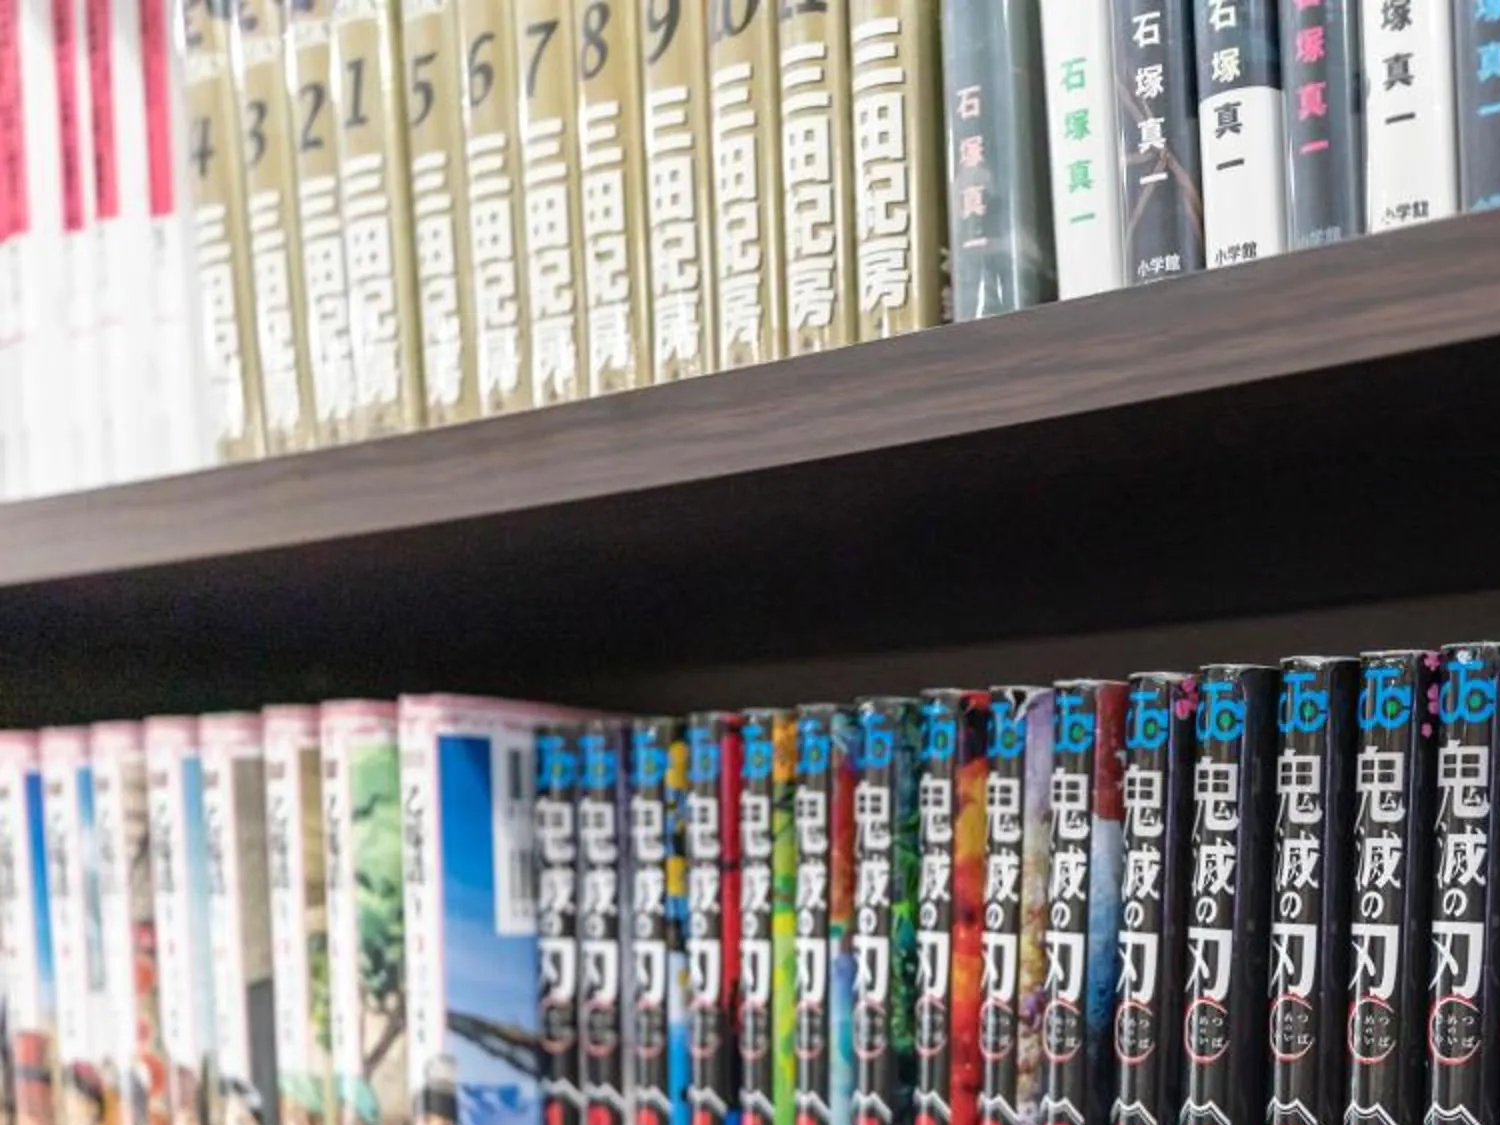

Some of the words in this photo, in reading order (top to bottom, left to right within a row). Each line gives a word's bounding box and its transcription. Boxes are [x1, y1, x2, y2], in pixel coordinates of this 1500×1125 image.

[300, 82, 325, 151] 2
[345, 57, 368, 128] 1
[411, 51, 438, 126] 5
[467, 33, 494, 106] 6
[525, 19, 559, 97] 7
[580, 0, 610, 80] 8
[1132, 11, 1168, 185] 石塚真一
[1209, 0, 1245, 171] 石塚真一
[1295, 0, 1329, 155] 塚真一
[247, 100, 268, 170] 3
[957, 85, 988, 248] 石塚真一
[1060, 57, 1095, 224] 石塚真一
[1382, 200, 1430, 225] 小学館
[1137, 254, 1181, 276] 小学館
[1215, 242, 1258, 265] 小学館
[687, 792, 720, 1001] 鬼滅の刃
[740, 790, 772, 1001] 鬼滅の刃
[794, 785, 828, 1001] 鬼滅の刃
[852, 781, 891, 1001] 鬼滅の刃
[916, 774, 953, 1002] 鬼滅の刃
[982, 771, 1020, 1001] 鬼滅の刃
[1045, 768, 1089, 1002] 鬼滅の刃
[1117, 765, 1163, 1003] 鬼滅の刃
[1185, 757, 1240, 1001] 鬼滅の刃
[1269, 749, 1323, 998] 鬼滅の刃
[1348, 746, 1405, 1001] 鬼滅の刃
[1429, 740, 1490, 1000] 鬼滅の刃
